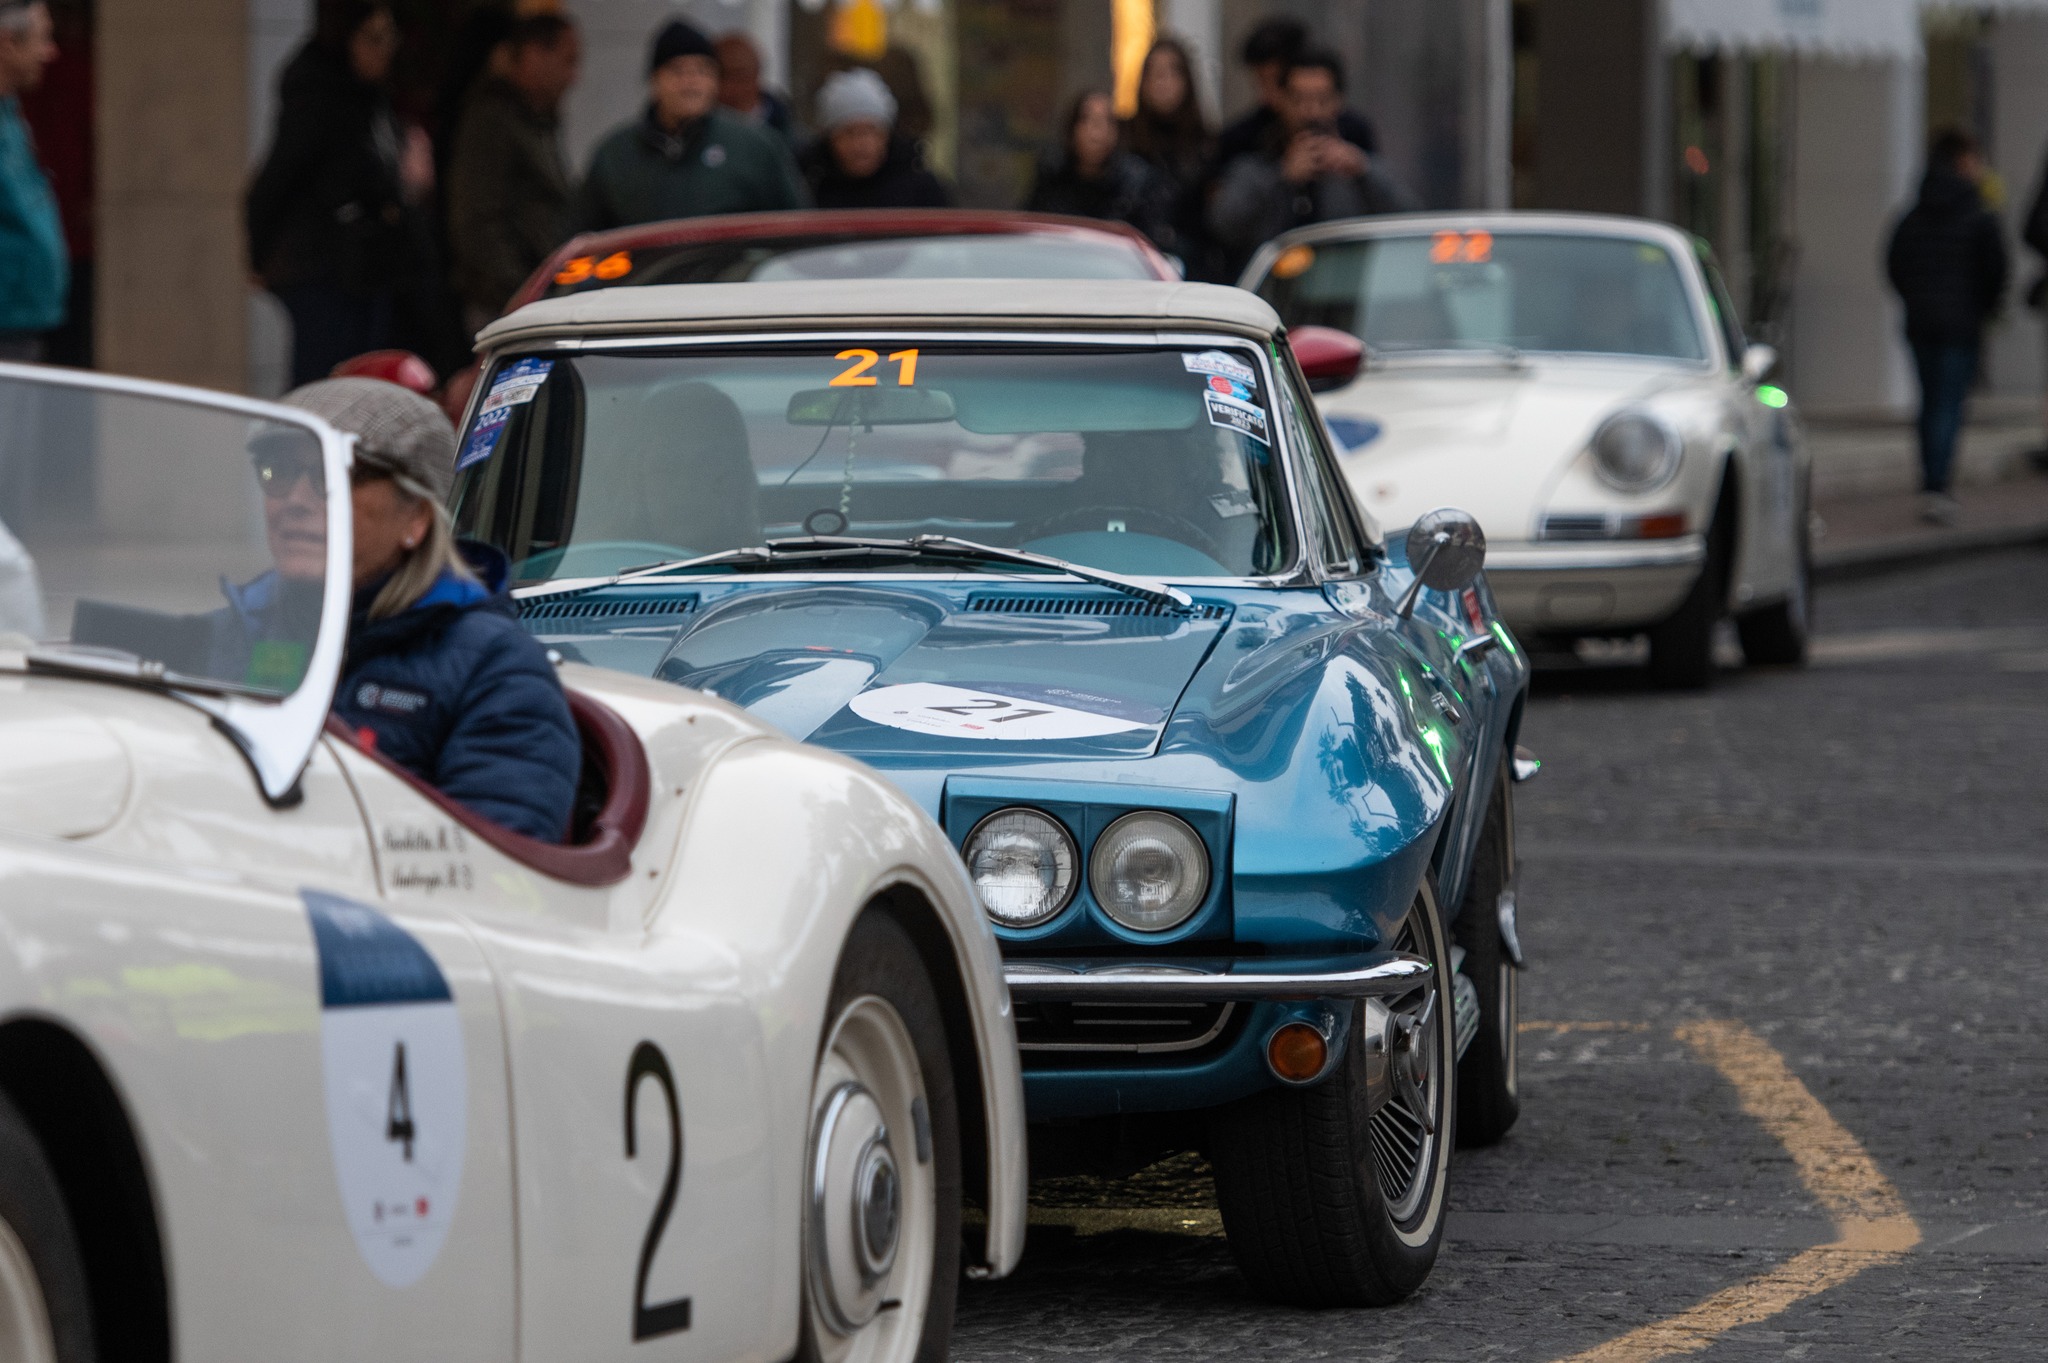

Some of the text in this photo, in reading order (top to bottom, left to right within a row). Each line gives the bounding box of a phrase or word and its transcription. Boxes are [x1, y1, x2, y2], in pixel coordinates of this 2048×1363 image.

[829, 348, 919, 386] 21
[1210, 402, 1265, 430] VERIFICATO
[925, 698, 1055, 724] 21
[386, 1041, 415, 1163] 4
[623, 1039, 691, 1343] 2
